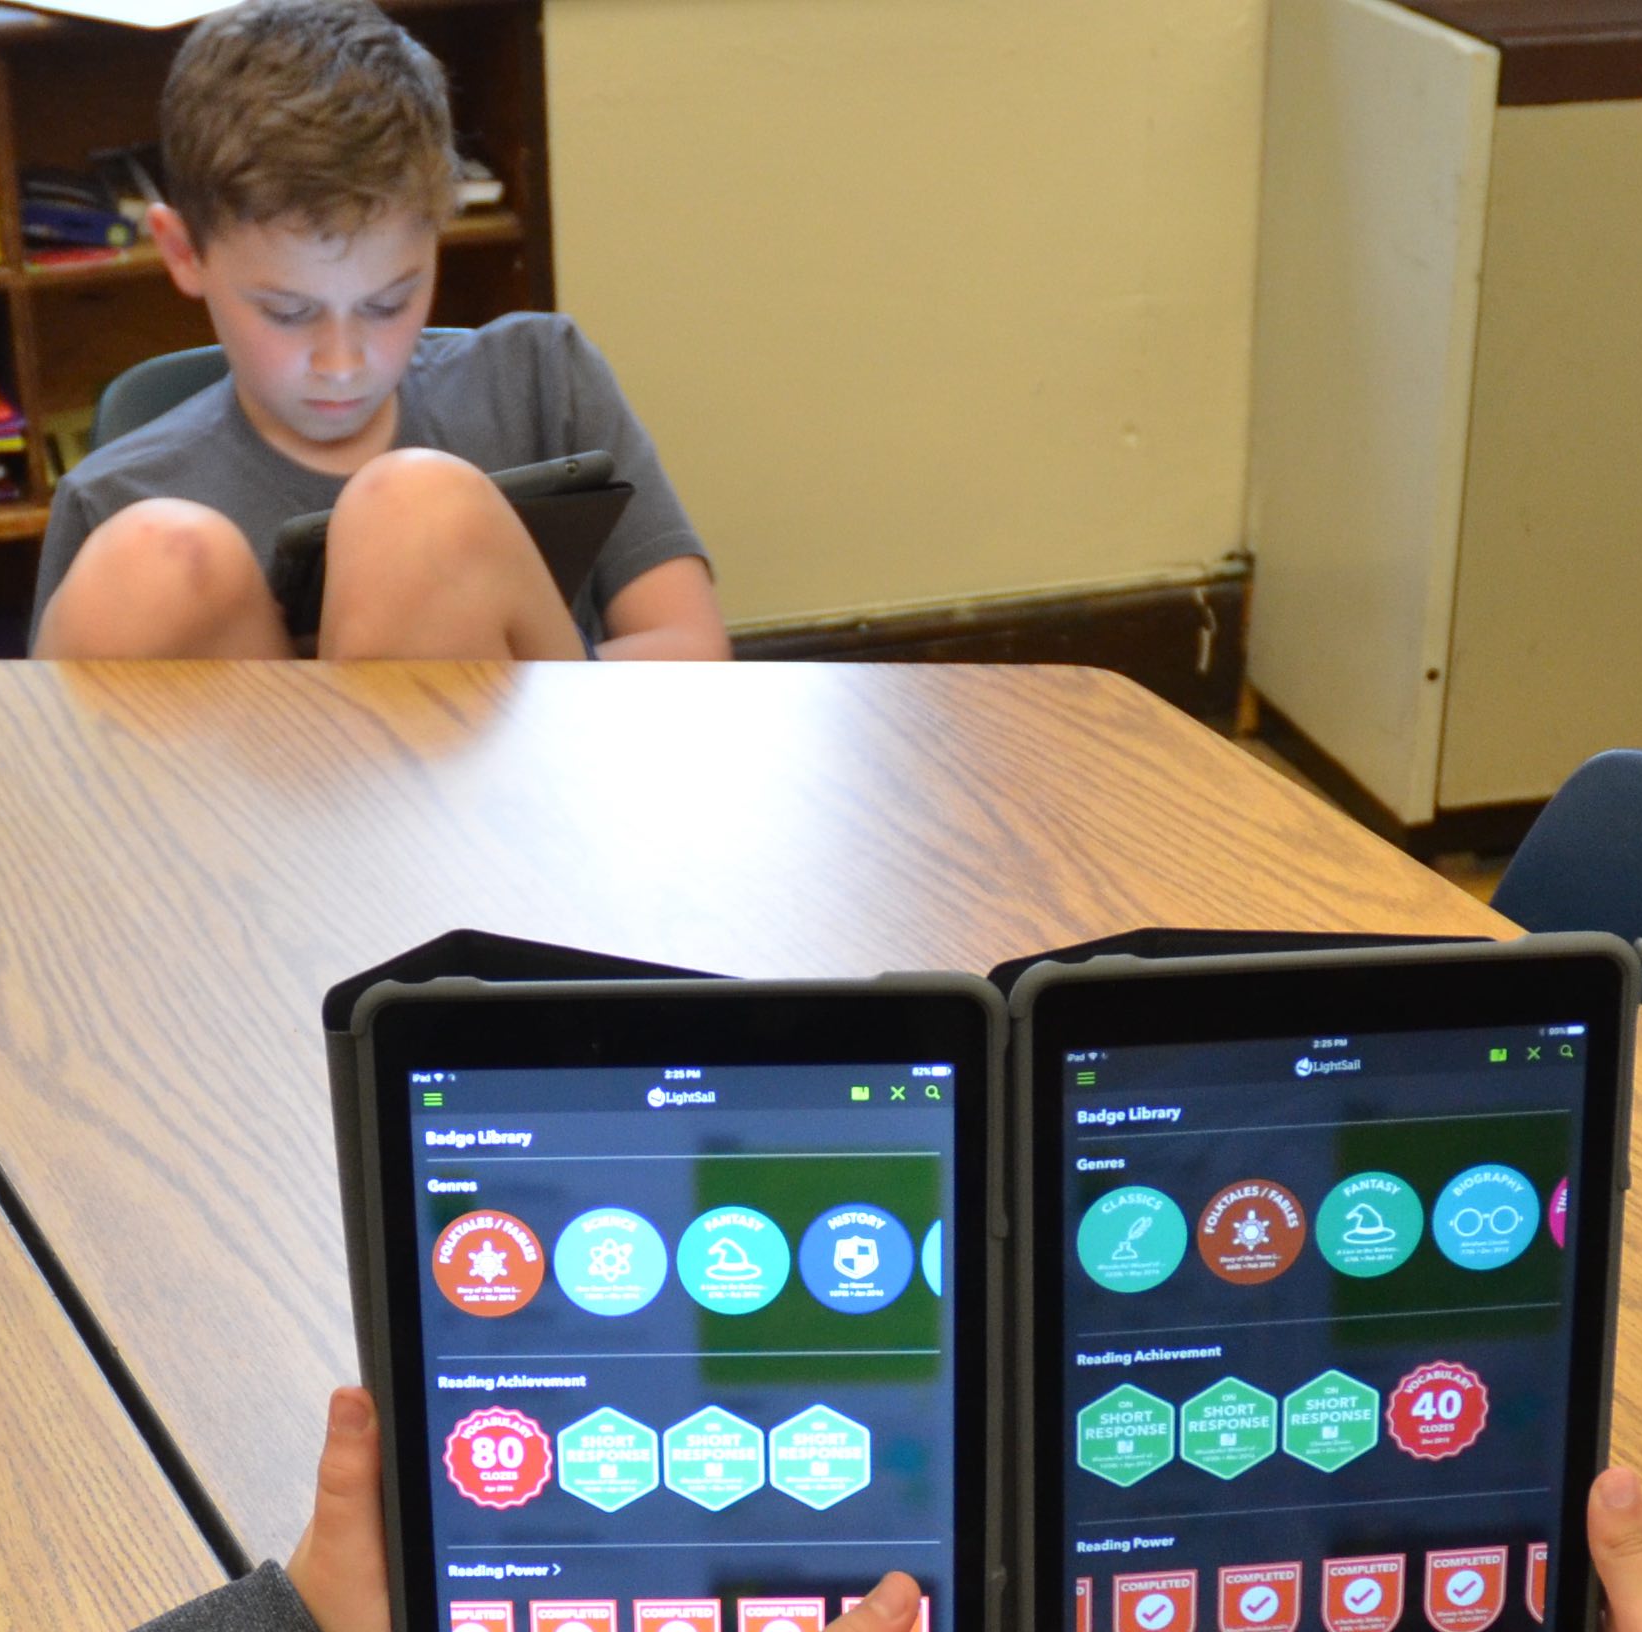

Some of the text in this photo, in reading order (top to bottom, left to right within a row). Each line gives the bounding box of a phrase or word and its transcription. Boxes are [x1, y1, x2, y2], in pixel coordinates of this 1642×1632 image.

[1313, 1038, 1348, 1048] 2:25 PM
[1067, 1053, 1085, 1062] iPad
[1312, 1059, 1361, 1073] LightSail
[412, 1073, 431, 1083] iPad
[664, 1070, 701, 1079] 2:25 PM
[665, 1091, 716, 1105] LightSail
[1077, 1106, 1181, 1125] Badge Library
[425, 1130, 532, 1148] Badge Library
[1076, 1157, 1125, 1170] Genres
[427, 1179, 478, 1192] Genres
[1343, 1178, 1401, 1197] FANTASY
[1452, 1171, 1525, 1197] BIOGRAPHY
[1102, 1193, 1163, 1213] CLASSICS
[1204, 1186, 1259, 1234] FOLKTALES
[1268, 1189, 1299, 1229] FABLES
[704, 1213, 765, 1233] FANTASY
[827, 1211, 886, 1230] HISTORY
[439, 1216, 494, 1265] FOLKTALES
[502, 1221, 538, 1263] FABLES
[1076, 1346, 1222, 1366] Reading Achievement
[437, 1374, 587, 1391] Reading Achievement
[1404, 1370, 1474, 1394] VOCABULARY
[1118, 1401, 1133, 1409] ON
[1306, 1396, 1359, 1410] SHORT
[1411, 1389, 1463, 1421] 40
[1100, 1410, 1153, 1425] SHORT
[1203, 1403, 1256, 1418] SHORT
[1291, 1409, 1371, 1425] RESPONSE
[460, 1417, 534, 1439] VOCABULARY
[1085, 1423, 1167, 1440] RESPONSE
[1188, 1416, 1270, 1433] RESPONSE
[1418, 1423, 1455, 1434] CLOZES
[581, 1435, 635, 1448] SHORT
[686, 1434, 741, 1447] SHORT
[792, 1432, 848, 1446] SHORT
[471, 1436, 524, 1469] 80
[566, 1449, 650, 1463] RESPONSE
[672, 1448, 756, 1461] RESPONSE
[778, 1446, 863, 1460] RESPONSE
[1076, 1537, 1175, 1553] Reading Power
[1433, 1555, 1501, 1569] COMPLETED
[448, 1563, 549, 1579] Reading Power
[1330, 1562, 1398, 1577] COMPLETED
[1120, 1578, 1190, 1592] COMPLETED
[1225, 1571, 1295, 1585] COMPLETED
[451, 1609, 506, 1620] MPLETED
[537, 1608, 610, 1620] COMPLETED
[641, 1607, 714, 1618] COMPLETED
[745, 1606, 818, 1618] COMPLETED
